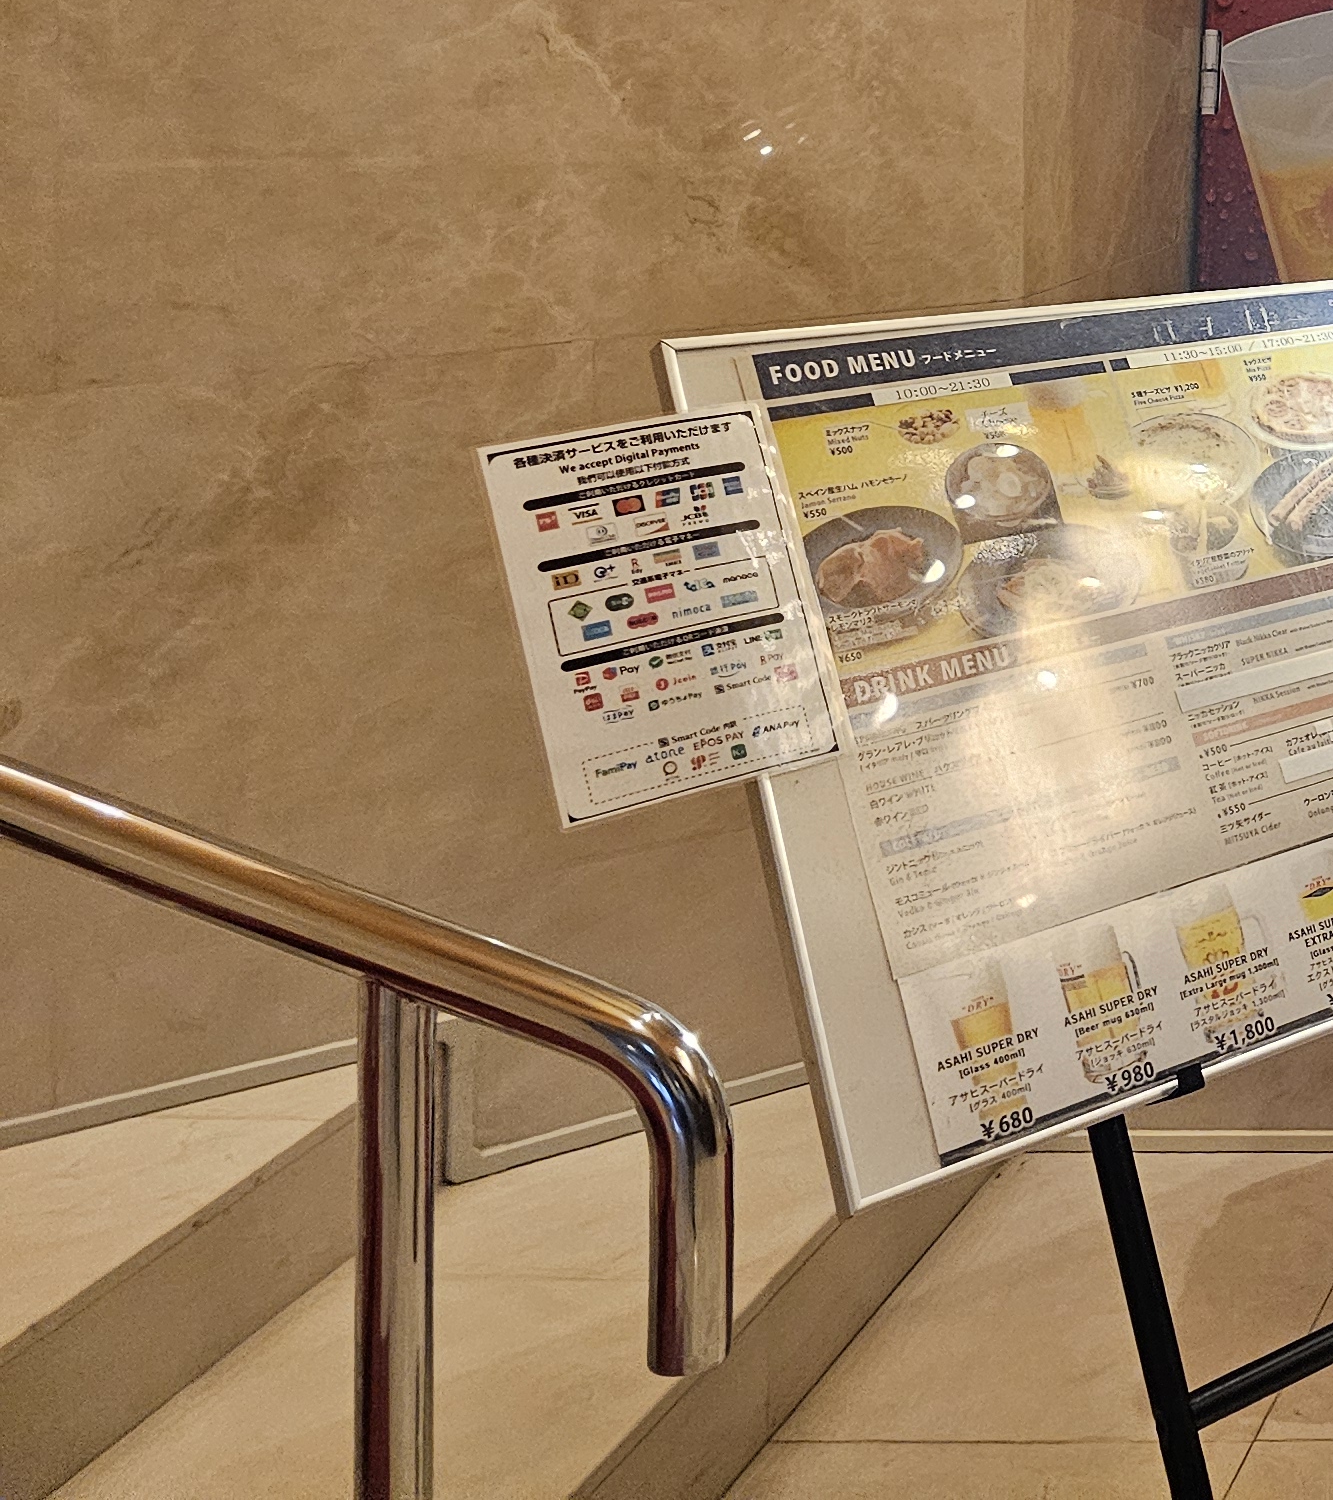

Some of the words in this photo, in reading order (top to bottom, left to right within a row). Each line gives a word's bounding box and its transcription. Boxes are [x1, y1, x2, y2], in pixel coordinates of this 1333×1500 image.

[768, 359, 840, 386] FOOD
[847, 349, 917, 375] MENU
[921, 346, 997, 365] フードメニュー
[1173, 381, 1200, 393] ¥1,200
[511, 420, 732, 469] 各種決済サービスをご利用いただけます
[829, 445, 854, 457] ¥500
[558, 462, 576, 474] We
[577, 457, 615, 473] accept
[614, 449, 650, 466] Digital
[650, 440, 701, 460] Payments
[826, 493, 857, 505] Serrano
[573, 508, 598, 520] VISA
[802, 508, 827, 520] ¥550
[553, 573, 579, 587] iD
[671, 601, 711, 619] nimoca
[838, 651, 863, 664] ¥650
[619, 662, 640, 677] Pay
[853, 668, 936, 705] DRINK
[940, 644, 1011, 681] MENU
[1175, 662, 1227, 682] スーパーニッカ
[726, 678, 750, 691] Smart
[752, 672, 772, 685] Code
[1187, 700, 1240, 722] ニッカセッション
[671, 730, 698, 744] Smart
[699, 723, 721, 736] Code
[692, 734, 724, 752] EPOS
[725, 729, 744, 742] PAY
[1285, 729, 1318, 748] カフェオレ
[644, 743, 685, 764] atone
[1203, 743, 1228, 758] ¥500
[594, 759, 638, 780] FamiPay
[1201, 757, 1233, 772] コーヒー
[1205, 768, 1231, 782] Coffee
[1222, 802, 1247, 817] ¥550
[1219, 810, 1273, 835] 三ツ矢サイダー
[1260, 820, 1282, 835] Cider
[1286, 923, 1317, 942] ASAHI
[1182, 966, 1214, 984] ASAHI
[1215, 954, 1248, 973] SUPER
[1248, 946, 1270, 961] DRY
[1204, 975, 1228, 992] Large
[1228, 970, 1247, 984] mug
[1062, 1007, 1096, 1027] ASAHI
[1098, 994, 1134, 1014] SUPER
[1135, 985, 1159, 1001] DRY
[1192, 978, 1278, 1017] アサヒスーパードライ
[1102, 1014, 1122, 1028] mug
[1075, 1020, 1164, 1060] アサヒスーパードライ
[1213, 1015, 1277, 1054] ¥1,800
[935, 1050, 973, 1071] ASAHI
[974, 1035, 1013, 1058] SUPER
[1015, 1026, 1040, 1044] DRY
[957, 1059, 991, 1079] [Glass
[1104, 1060, 1155, 1093] ¥980
[947, 1063, 1045, 1107] アサヒスーパードライ
[979, 1105, 1034, 1141] ¥680
